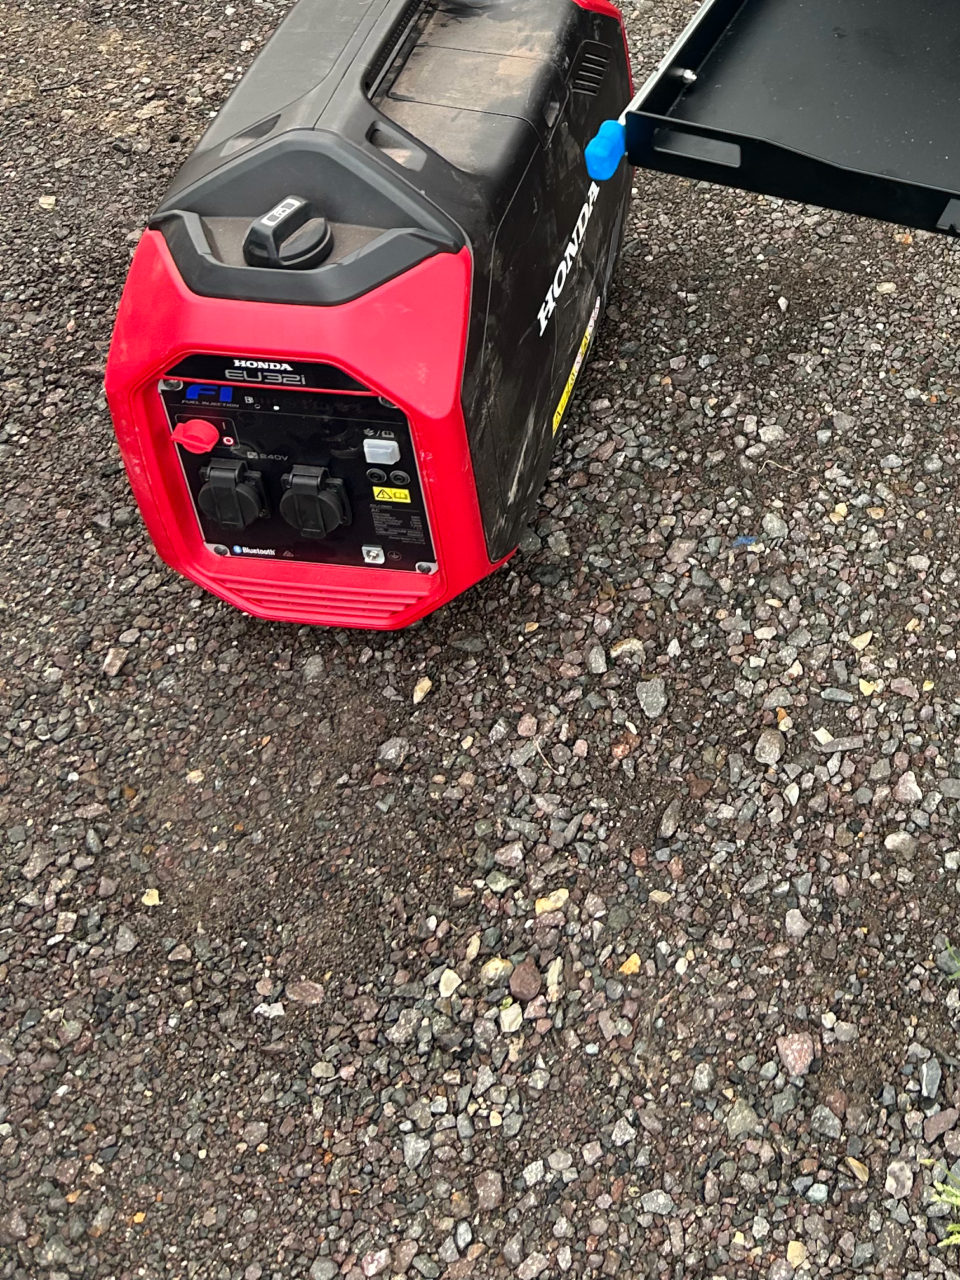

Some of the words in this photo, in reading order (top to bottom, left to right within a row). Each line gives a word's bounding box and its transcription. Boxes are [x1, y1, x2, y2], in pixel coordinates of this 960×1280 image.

[537, 180, 600, 337] HONDA
[233, 359, 293, 371] HONDA
[225, 369, 305, 385] EU32i
[186, 384, 233, 403] FI
[259, 453, 289, 461] 240V
[242, 546, 276, 556] Bluetooth
